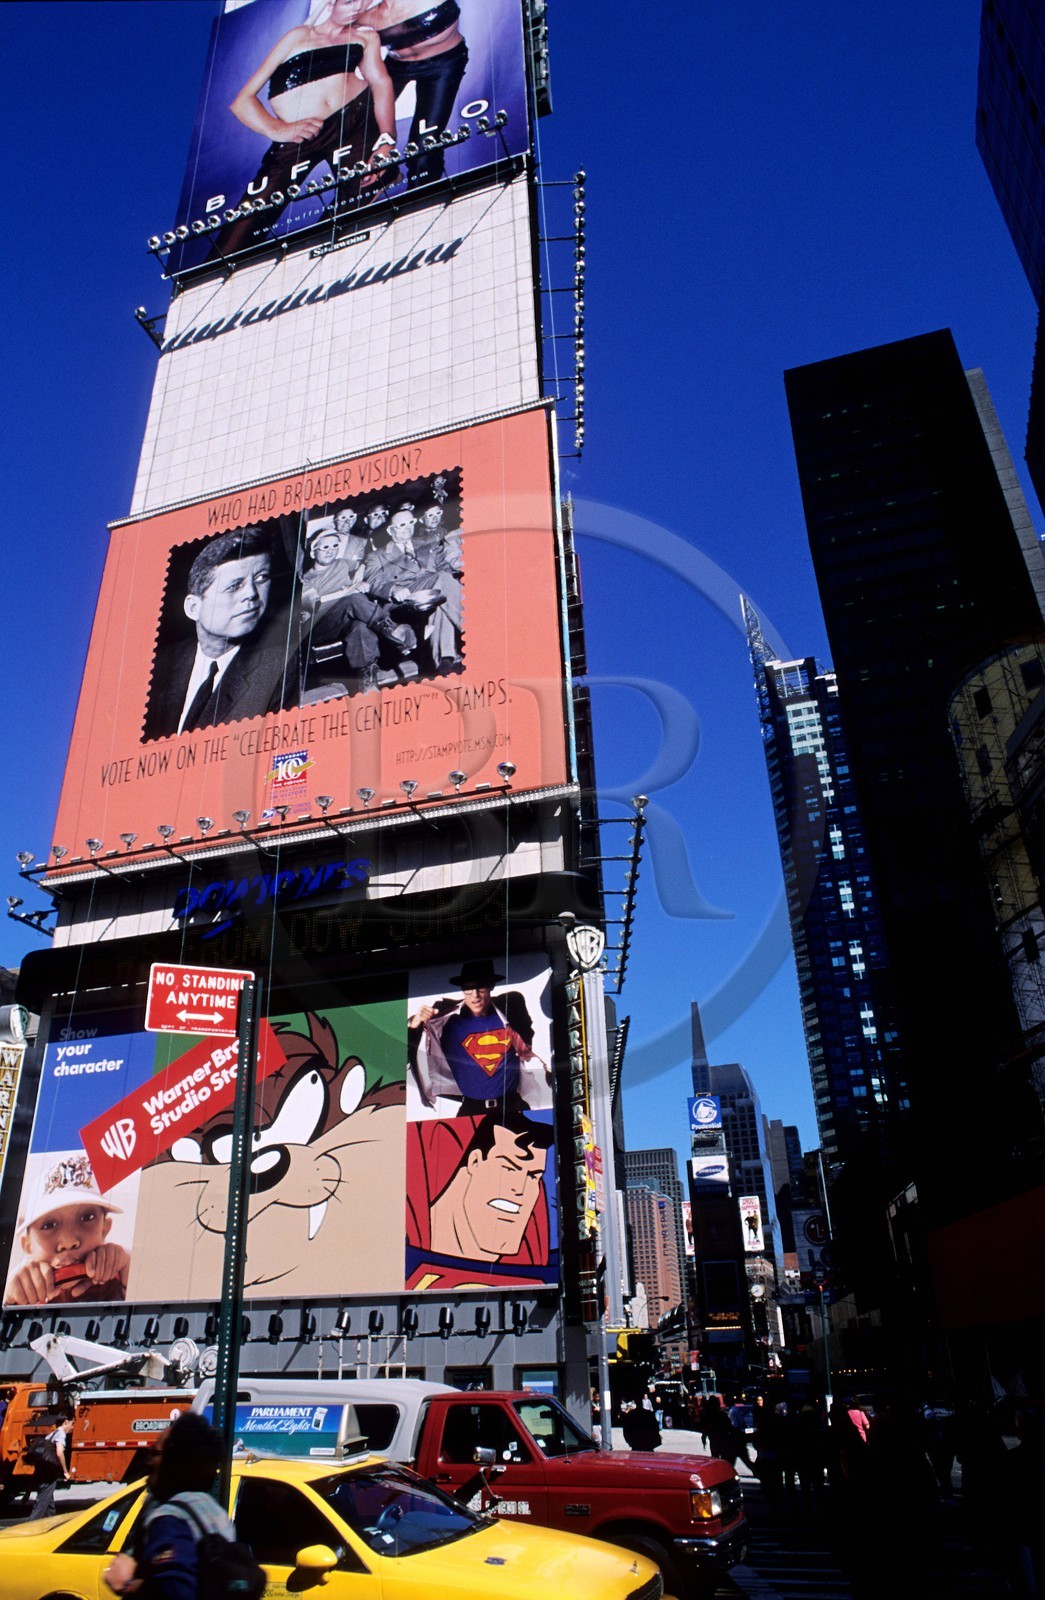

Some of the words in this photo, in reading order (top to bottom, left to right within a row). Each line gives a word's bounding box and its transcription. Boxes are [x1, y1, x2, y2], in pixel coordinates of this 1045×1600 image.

[205, 99, 489, 214] BUFFALO
[207, 498, 242, 528] WHO
[247, 489, 277, 517] HAD
[283, 468, 351, 508] BROADER
[358, 448, 423, 486] VISION?
[101, 758, 134, 788] VOTE
[136, 748, 172, 780] NOW
[176, 744, 198, 769] ON
[203, 736, 230, 765] THE
[321, 710, 350, 741] THE
[444, 678, 513, 716] STAMPS.
[155, 971, 175, 986] NO
[165, 990, 236, 1009] ANYTIME
[59, 1027, 99, 1040] Show
[55, 1043, 92, 1061] your
[564, 983, 585, 1122] WARNER
[53, 1058, 124, 1077] character
[142, 1060, 213, 1116] Warner
[209, 1039, 241, 1069] Bro
[149, 1085, 211, 1135] Studio
[691, 1122, 722, 1130] Prudential
[100, 1118, 137, 1161] WB
[250, 1407, 313, 1417] PARLIAMENT
[239, 1419, 279, 1432] Menthol
[279, 1418, 311, 1435] Lights
